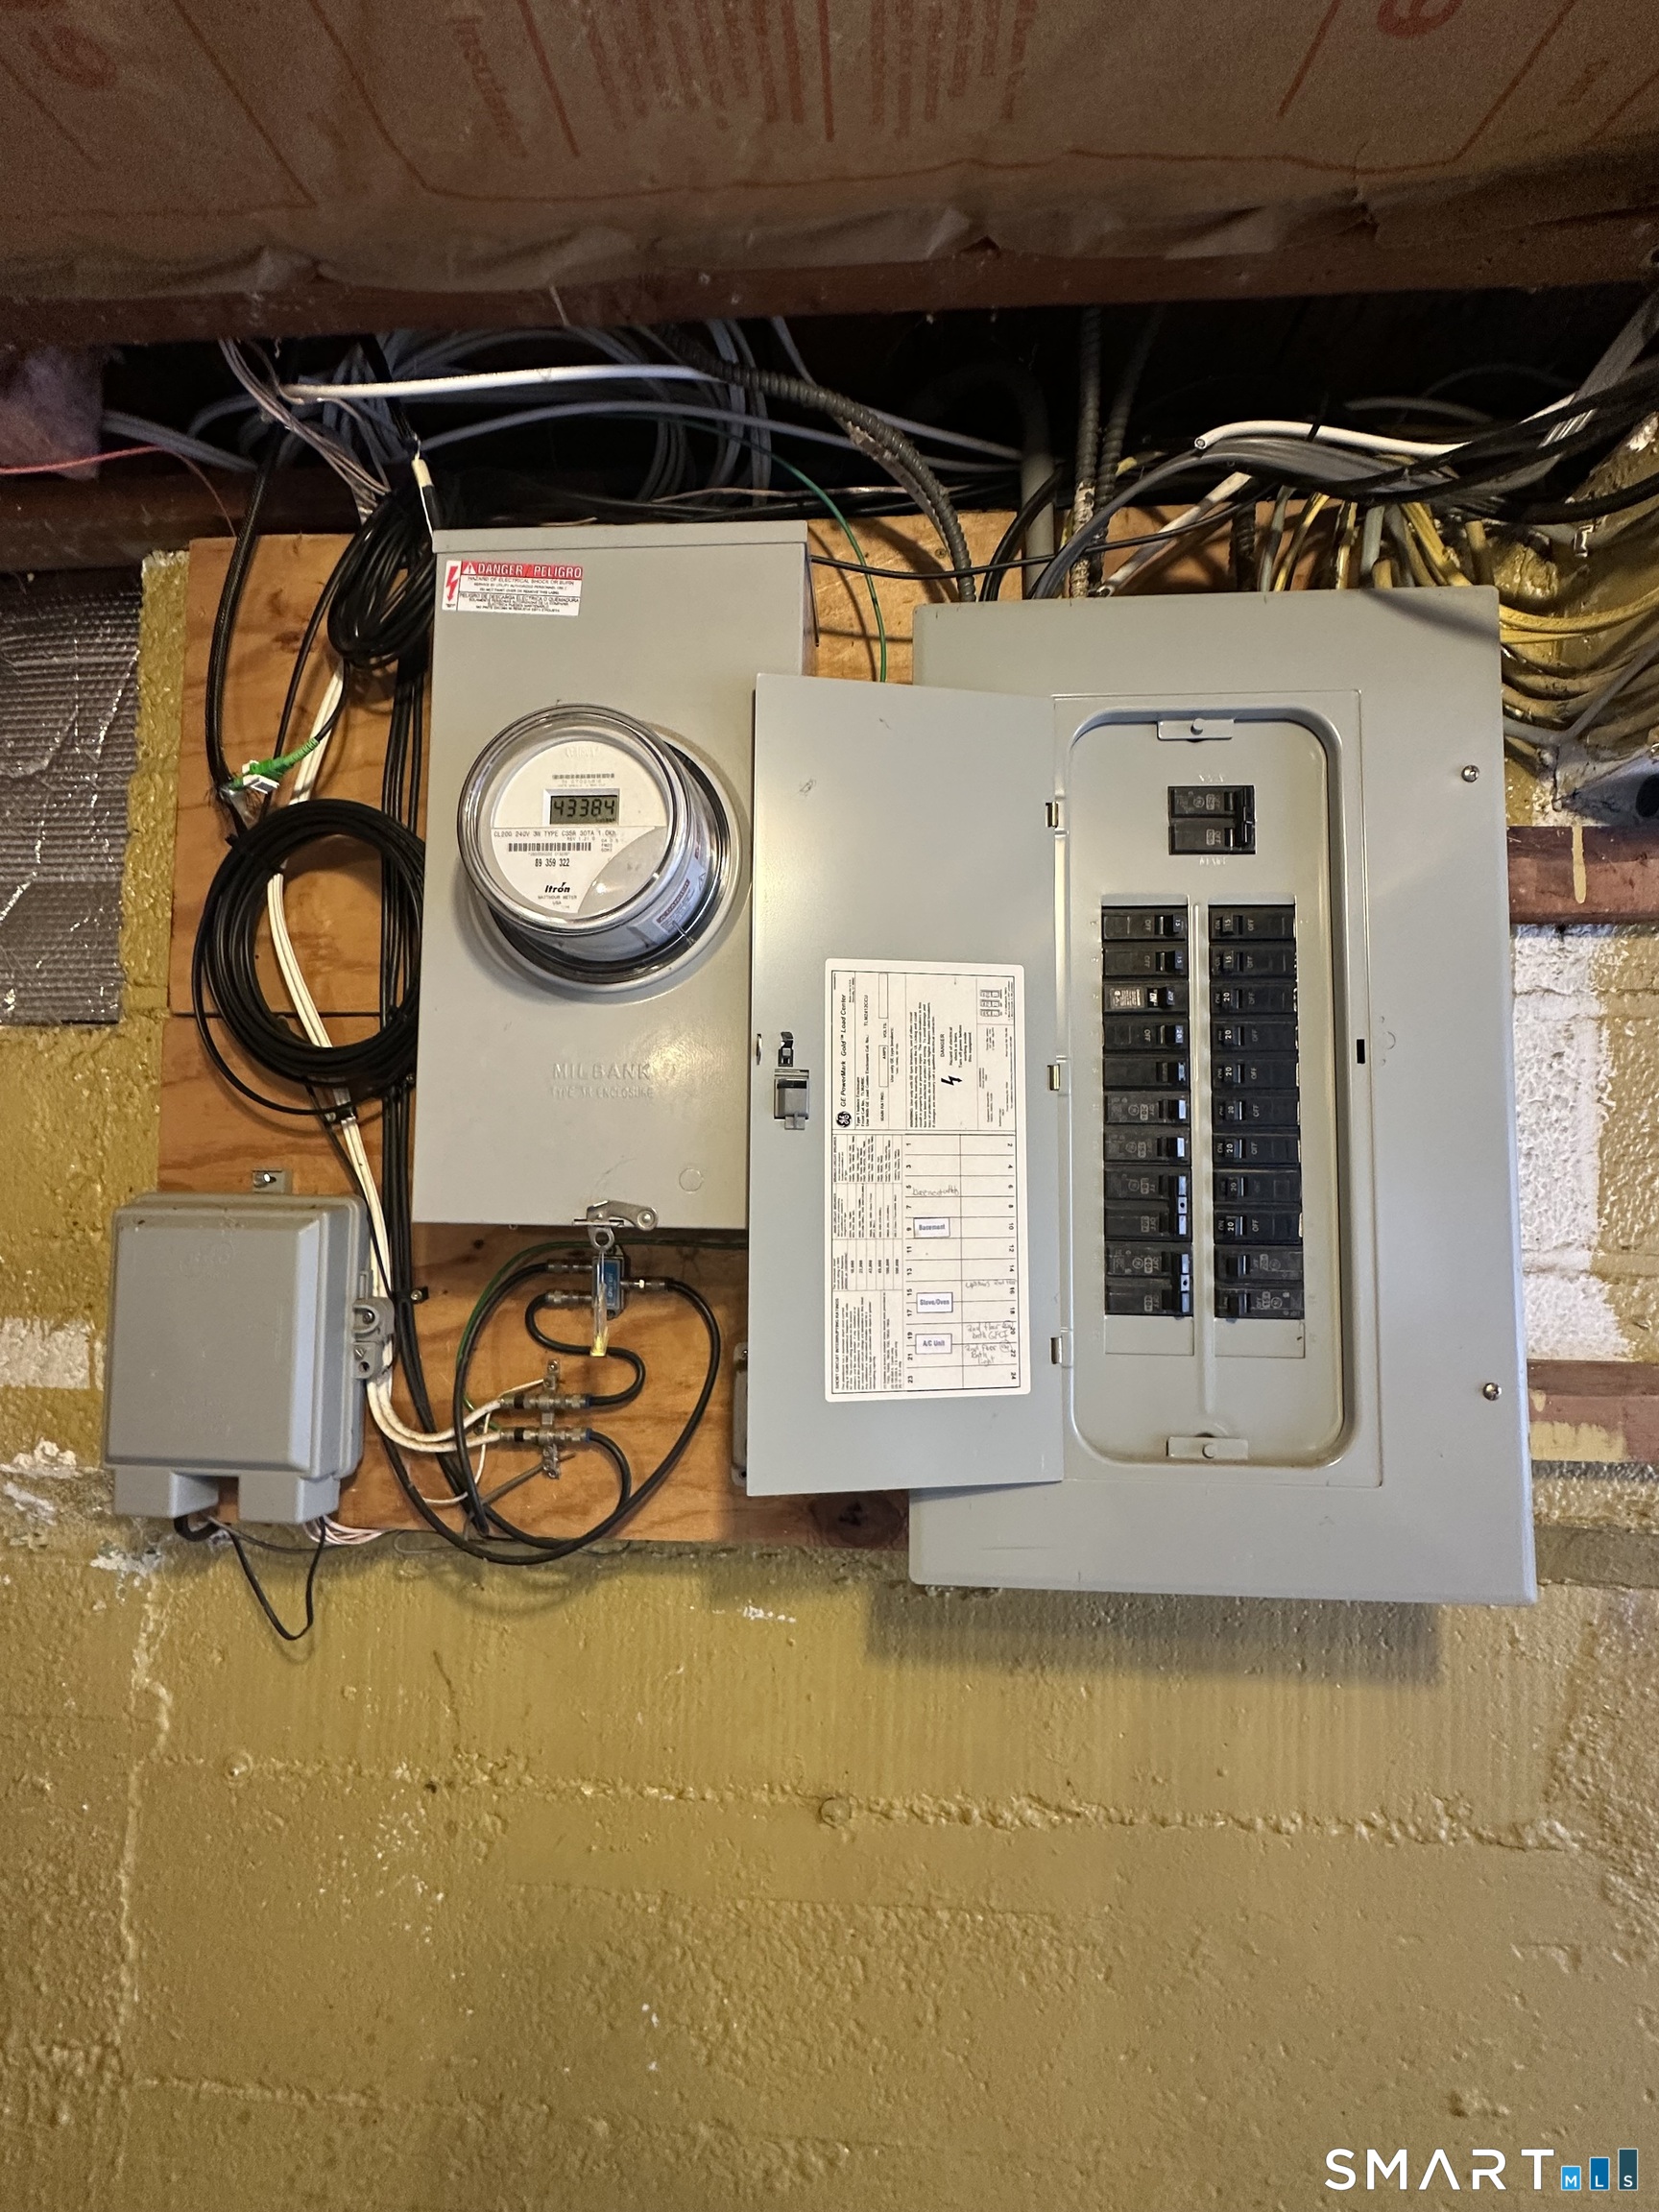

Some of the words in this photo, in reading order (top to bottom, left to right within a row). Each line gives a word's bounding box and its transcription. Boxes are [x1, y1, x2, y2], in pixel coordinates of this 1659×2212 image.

[478, 563, 523, 574] DANGER
[534, 565, 582, 578] PELIGRO
[553, 799, 615, 817] 43384
[535, 858, 542, 867] 89
[545, 858, 556, 867] 359
[559, 858, 570, 867] 322
[1223, 992, 1230, 1002] 20
[1225, 1030, 1231, 1039] 20
[553, 1063, 650, 1081] MILBANK
[1226, 1067, 1232, 1076] 20
[840, 1096, 846, 1107] GE
[1227, 1144, 1233, 1153] 20
[1231, 1182, 1237, 1191] 20
[1227, 1221, 1234, 1231] 20
